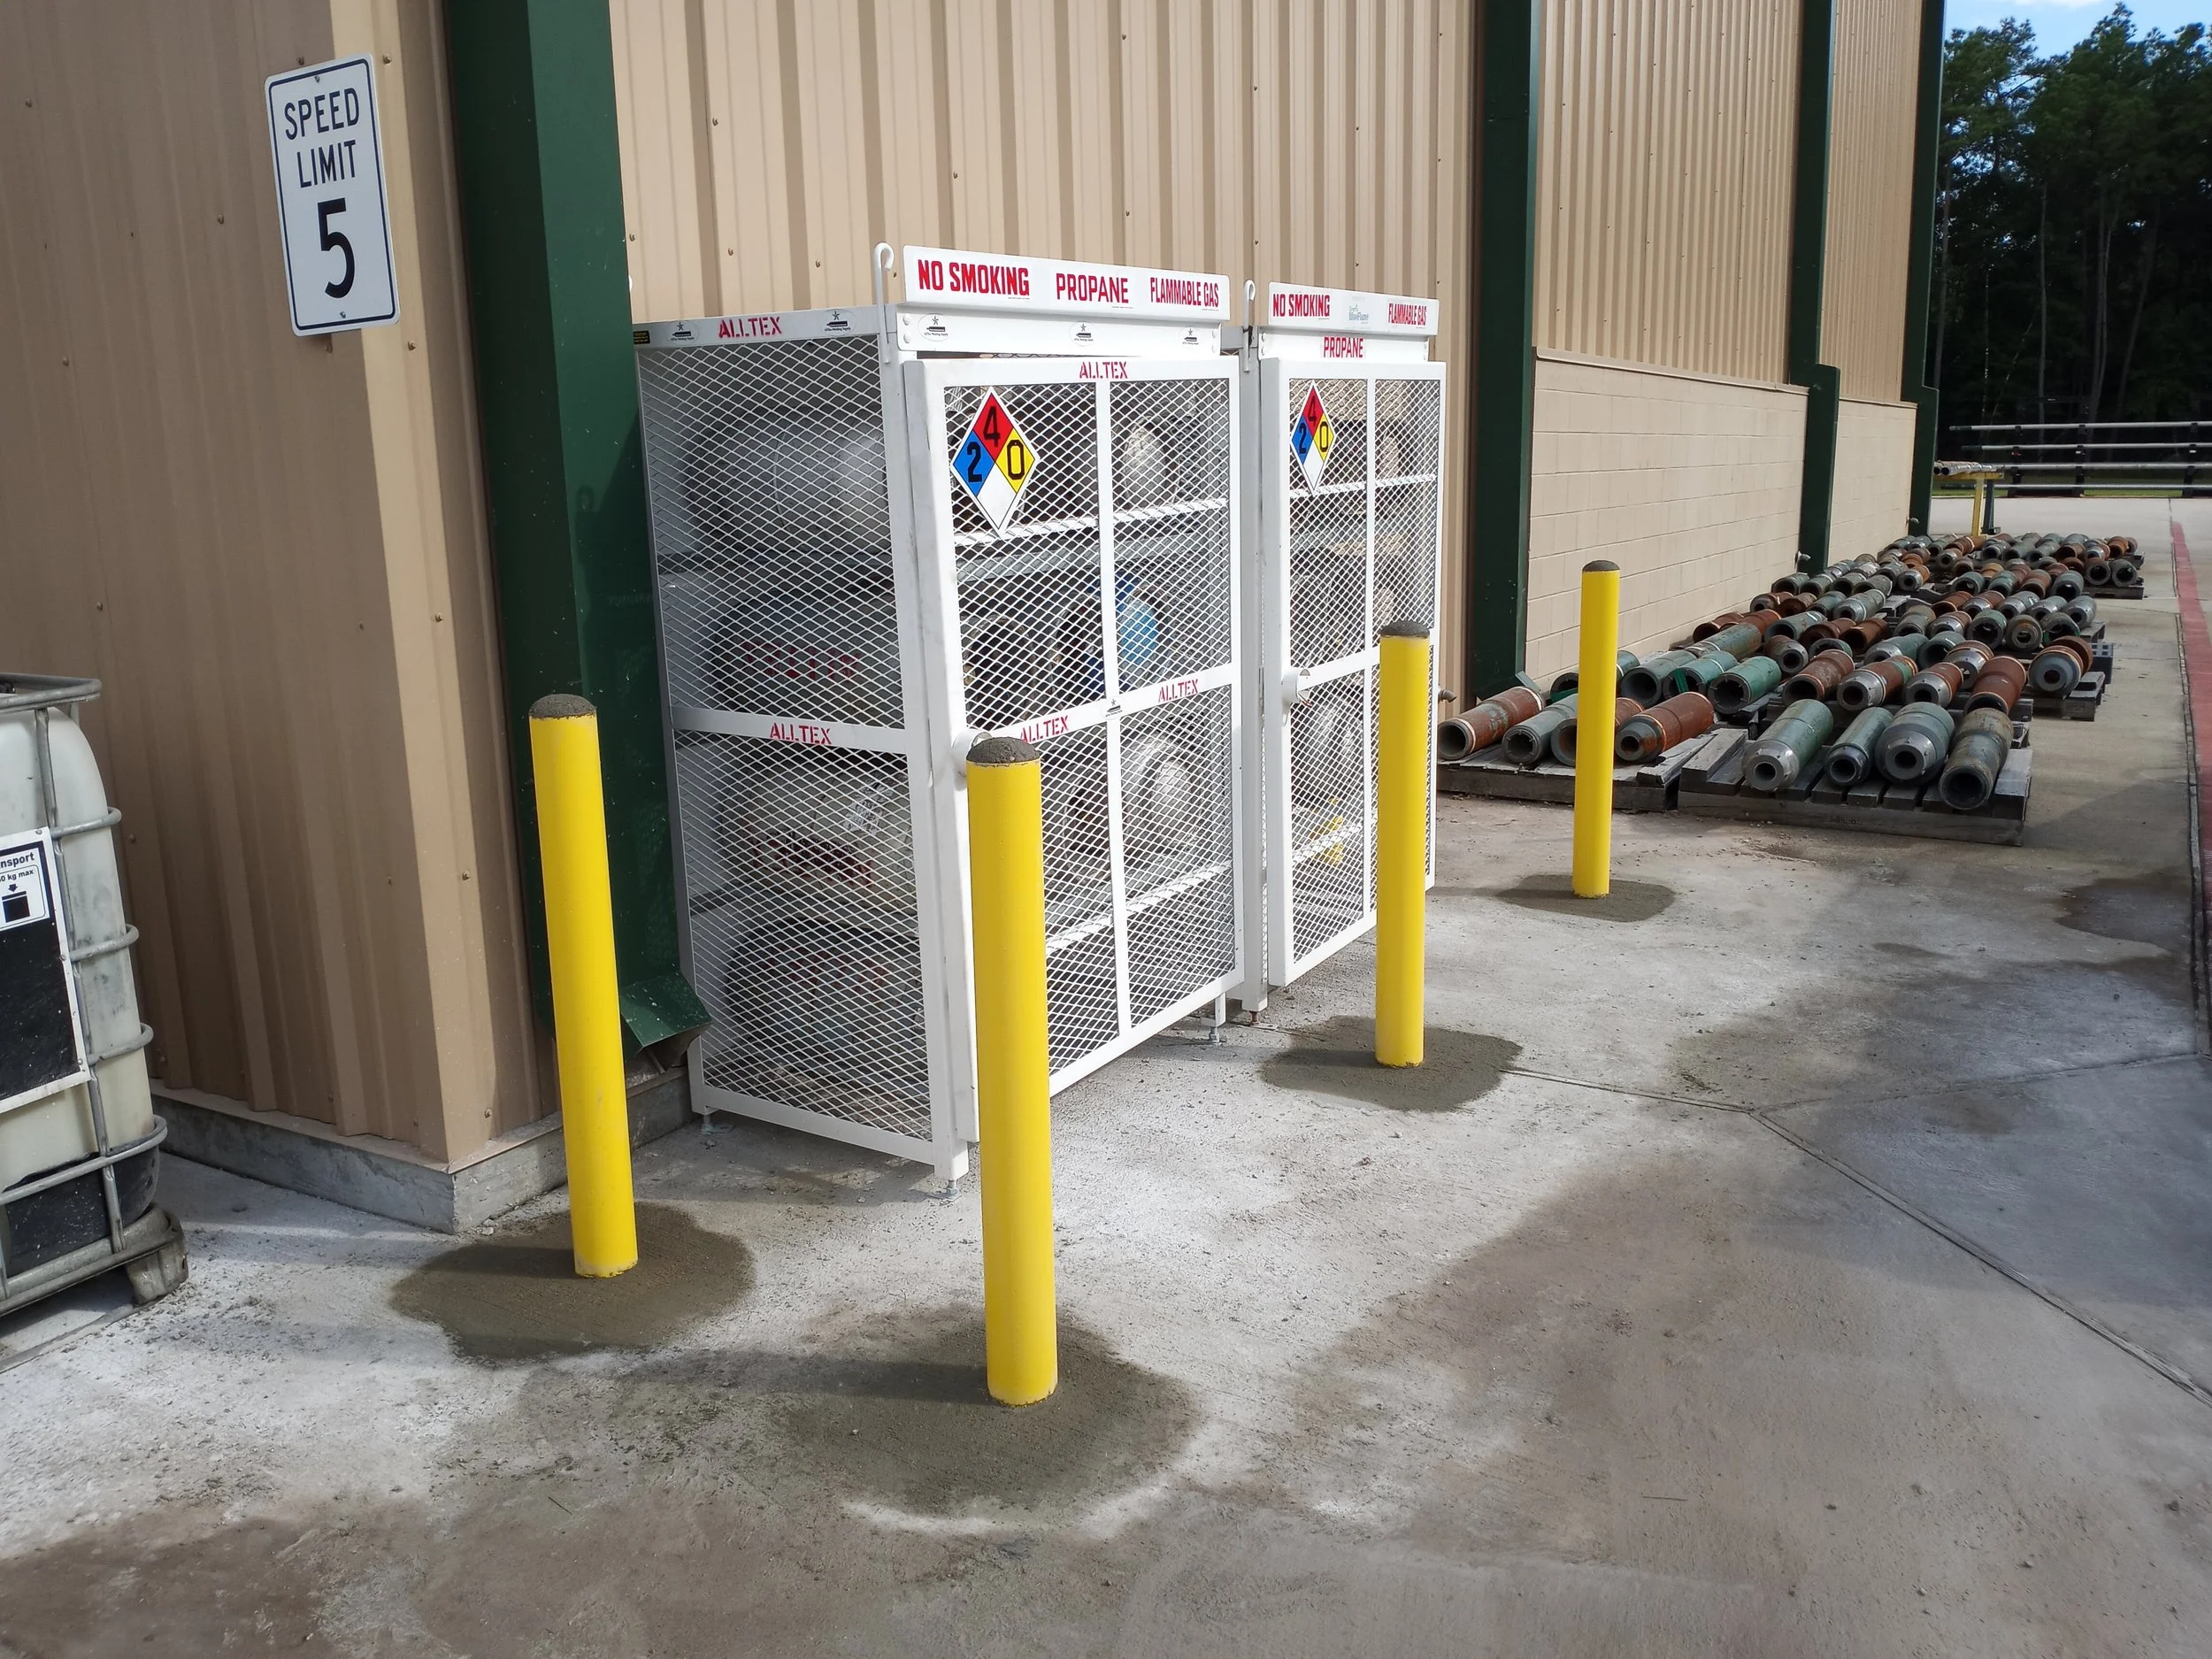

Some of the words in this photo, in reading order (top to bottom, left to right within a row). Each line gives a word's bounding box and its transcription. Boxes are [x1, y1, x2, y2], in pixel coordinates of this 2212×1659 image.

[284, 87, 359, 141] SPEED
[296, 139, 357, 188] LIMIT
[318, 197, 356, 298] 5
[918, 259, 944, 291] NO
[949, 262, 1030, 296] SMOKING
[1056, 273, 1129, 303] PROPANE
[1150, 276, 1202, 306] FLAMMABLE
[1203, 281, 1219, 308] GAS
[1272, 293, 1286, 317] NO
[1288, 293, 1330, 317] SMOKING
[1388, 303, 1417, 326] FLAMMABLE
[1417, 304, 1427, 326] GAS
[718, 316, 782, 339] ALLTEX
[1323, 336, 1363, 358] PROPANE
[1079, 361, 1128, 380] ALLTEX
[1308, 396, 1317, 426] 4
[983, 405, 1001, 448] 4
[1298, 422, 1307, 454] 2
[1319, 420, 1329, 452] 0
[966, 441, 982, 483] 2
[1006, 439, 1025, 480] 0
[1158, 679, 1198, 703] ALLTEX
[770, 722, 832, 745] ALLTEX
[1020, 715, 1068, 743] ALLTEX
[19, 869, 35, 878] max
